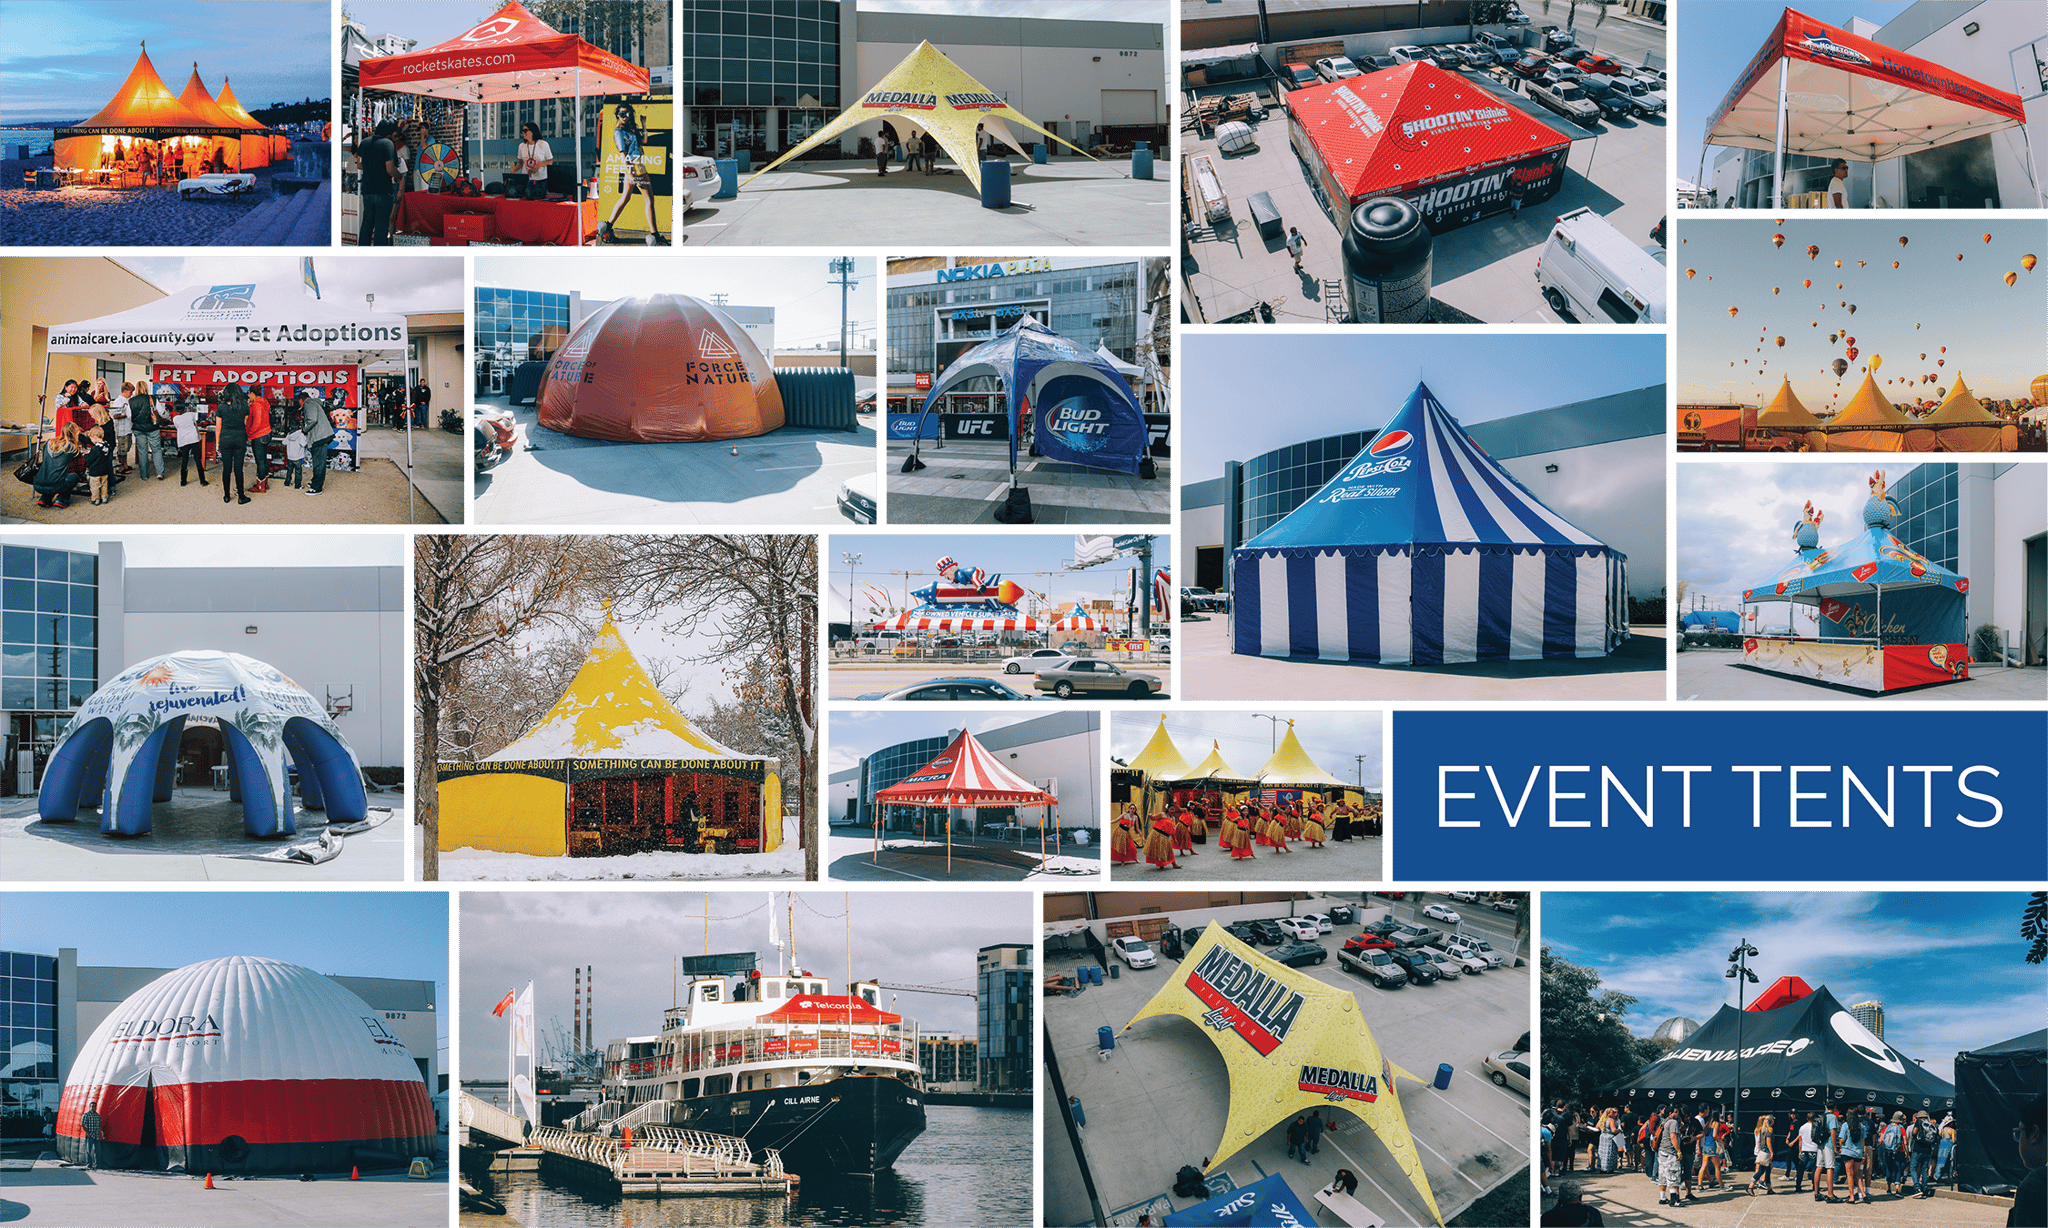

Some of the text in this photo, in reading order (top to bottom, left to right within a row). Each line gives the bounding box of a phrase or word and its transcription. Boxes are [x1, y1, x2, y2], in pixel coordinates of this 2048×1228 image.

[402, 53, 516, 74] rocketskates.com
[866, 91, 937, 105] MEDALLA
[943, 93, 1007, 105] MEDALLA
[1402, 107, 1508, 135] SHOOTIN' Blanks
[606, 154, 662, 165] AMAZING
[605, 164, 635, 174] FEET.
[1511, 162, 1554, 184] Blanks
[1437, 200, 1476, 218] VIRTUAL
[1527, 178, 1551, 190] RANGE
[937, 258, 1052, 283] NOKIA PLAZA
[236, 322, 402, 347] Pet Adoptions
[686, 361, 745, 373] FORCE
[159, 369, 197, 382] PET
[686, 371, 757, 385] NATURE
[1060, 407, 1101, 421] BUD
[957, 420, 995, 434] UFC
[1052, 419, 1110, 435] LIGHT
[1363, 487, 1401, 497] SUGAR
[169, 682, 199, 695] live
[149, 684, 246, 713] rejuvenated!
[437, 759, 564, 772] OMETHING CAN BE DONE ABOUT IT
[572, 759, 760, 770] SOMETHING CAN BE DONE ABOUT IT
[905, 774, 946, 783] MICRA
[1194, 942, 1307, 1042] MEDALLA
[385, 1012, 407, 1020] 9872
[1201, 1006, 1237, 1032] Light
[112, 1013, 219, 1038] ELDORA
[1299, 1065, 1378, 1096] MEDALLA
[784, 1096, 821, 1105] CILL AIRNE
[1214, 1192, 1256, 1218] Silk
